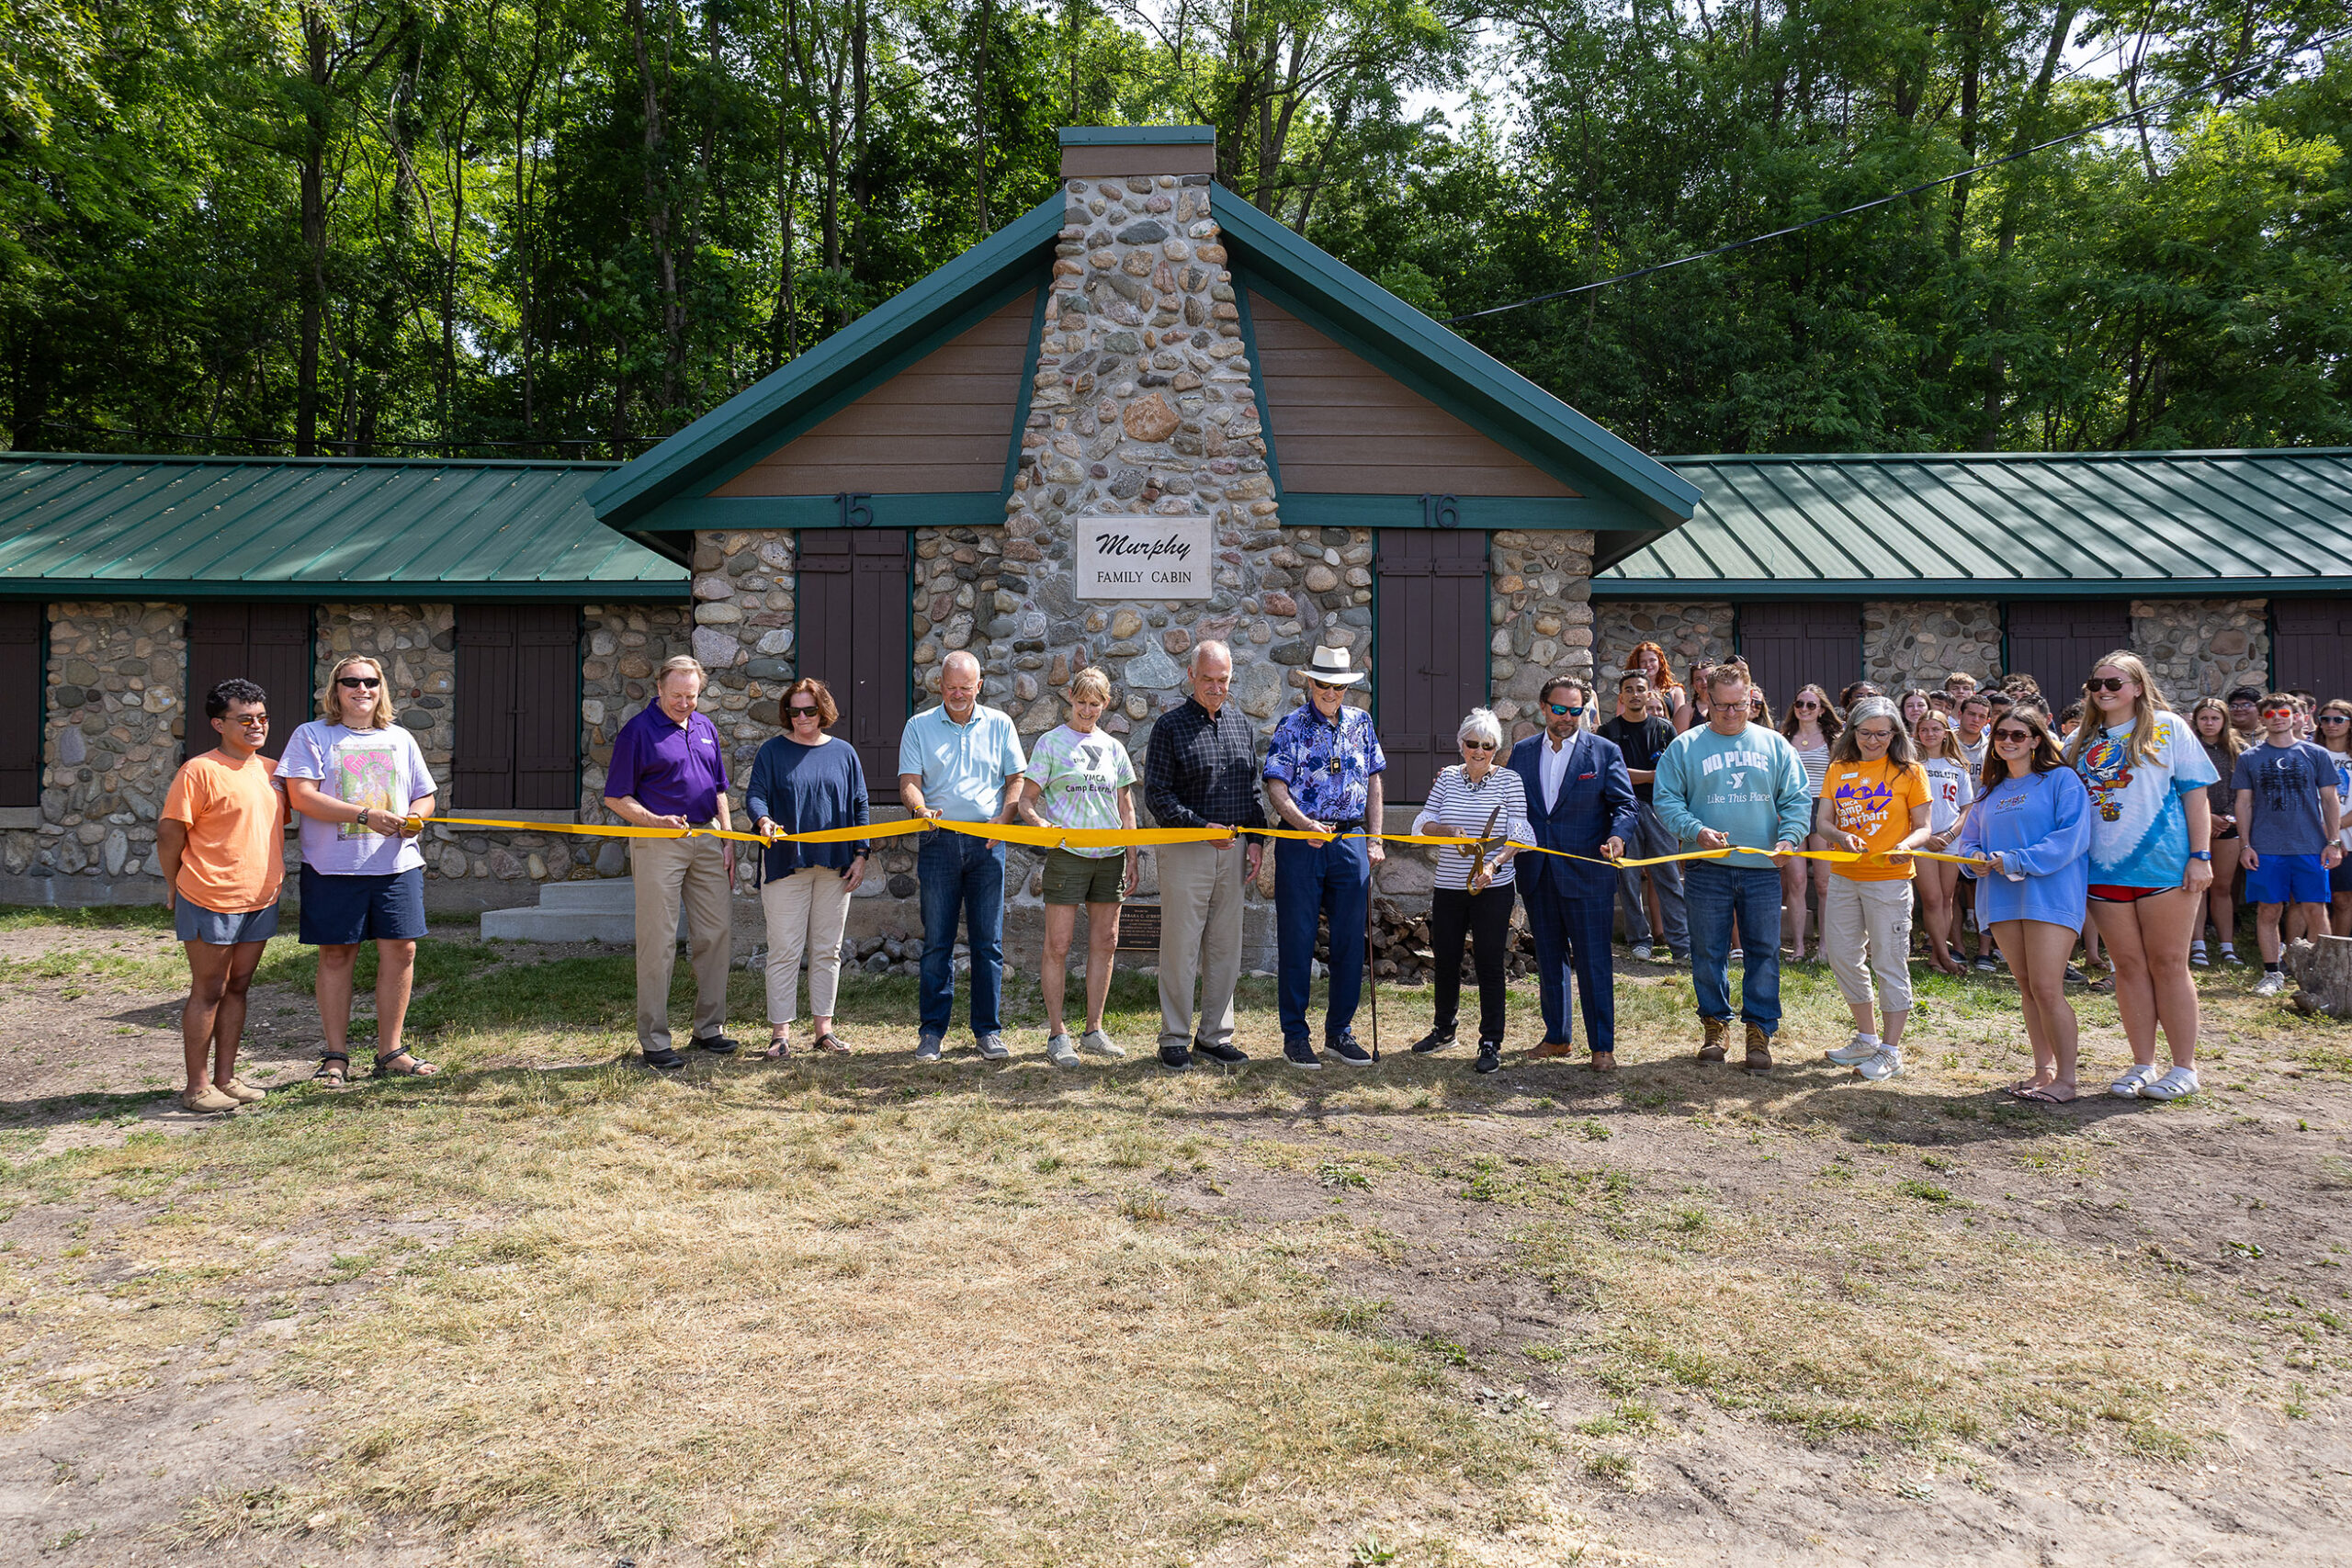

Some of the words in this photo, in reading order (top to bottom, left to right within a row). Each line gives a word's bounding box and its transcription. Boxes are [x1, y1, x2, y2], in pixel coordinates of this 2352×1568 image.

[833, 492, 873, 527] 15
[1418, 492, 1460, 528] 16
[1096, 534, 1191, 560] Murphy
[1097, 571, 1144, 583] FAMILY
[1151, 571, 1192, 583] CABIN
[1702, 753, 1724, 776] NO
[1724, 750, 1770, 773] PLACE
[1083, 774, 1106, 783] YMCA
[1066, 784, 1087, 793] Camp
[1942, 783, 1957, 802] 19
[1707, 794, 1725, 804] Like
[1728, 793, 1747, 803] This
[1749, 792, 1770, 802] Place
[1836, 804, 1862, 817] Camp
